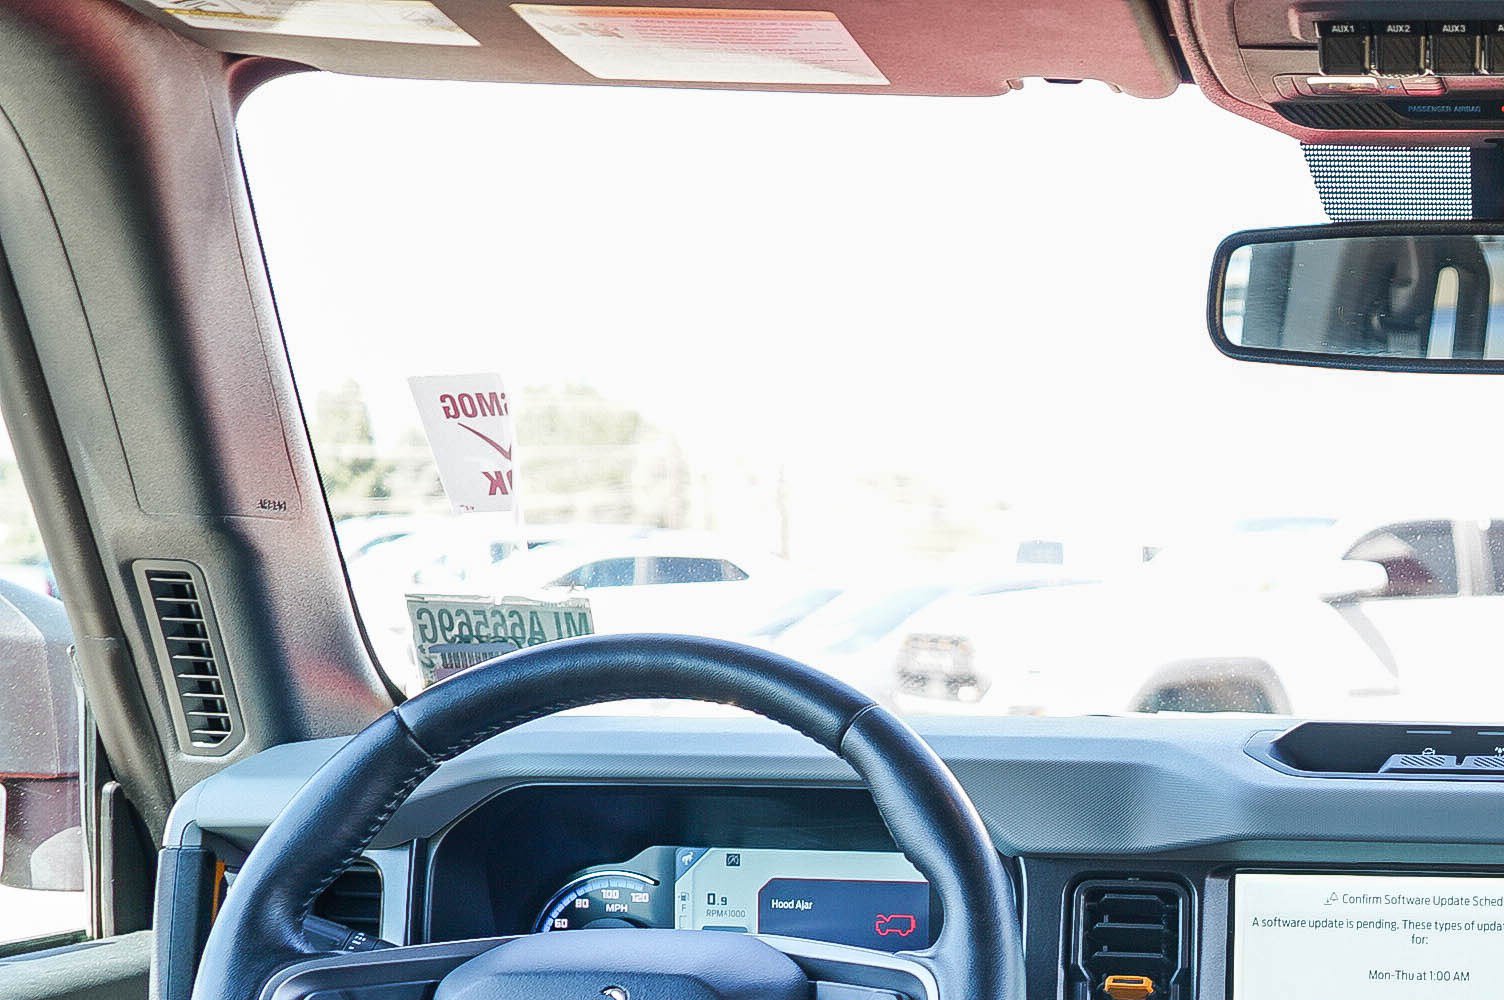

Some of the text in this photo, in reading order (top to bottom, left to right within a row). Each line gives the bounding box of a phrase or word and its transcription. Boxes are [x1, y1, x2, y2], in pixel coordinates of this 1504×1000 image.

[601, 889, 619, 899] 100
[631, 892, 650, 903] 120
[707, 893, 728, 906] 0.9
[575, 899, 589, 909] 80
[771, 899, 814, 911] Hood Ajar
[1342, 893, 1382, 905] Confirm
[1384, 894, 1431, 906] Software
[1432, 895, 1471, 908] Update
[605, 903, 628, 914] MPH
[681, 904, 687, 912] F
[554, 919, 568, 929] 60
[1251, 917, 1260, 927] A
[1262, 917, 1307, 928] software
[1309, 918, 1344, 930] update
[1346, 919, 1354, 929] is
[1356, 919, 1400, 932] pending.
[1402, 920, 1433, 931] These
[1434, 921, 1462, 933] types
[1464, 921, 1475, 931] of
[1411, 934, 1429, 945] for:
[1368, 969, 1470, 982] Mon-Thu at 1:00 AM
